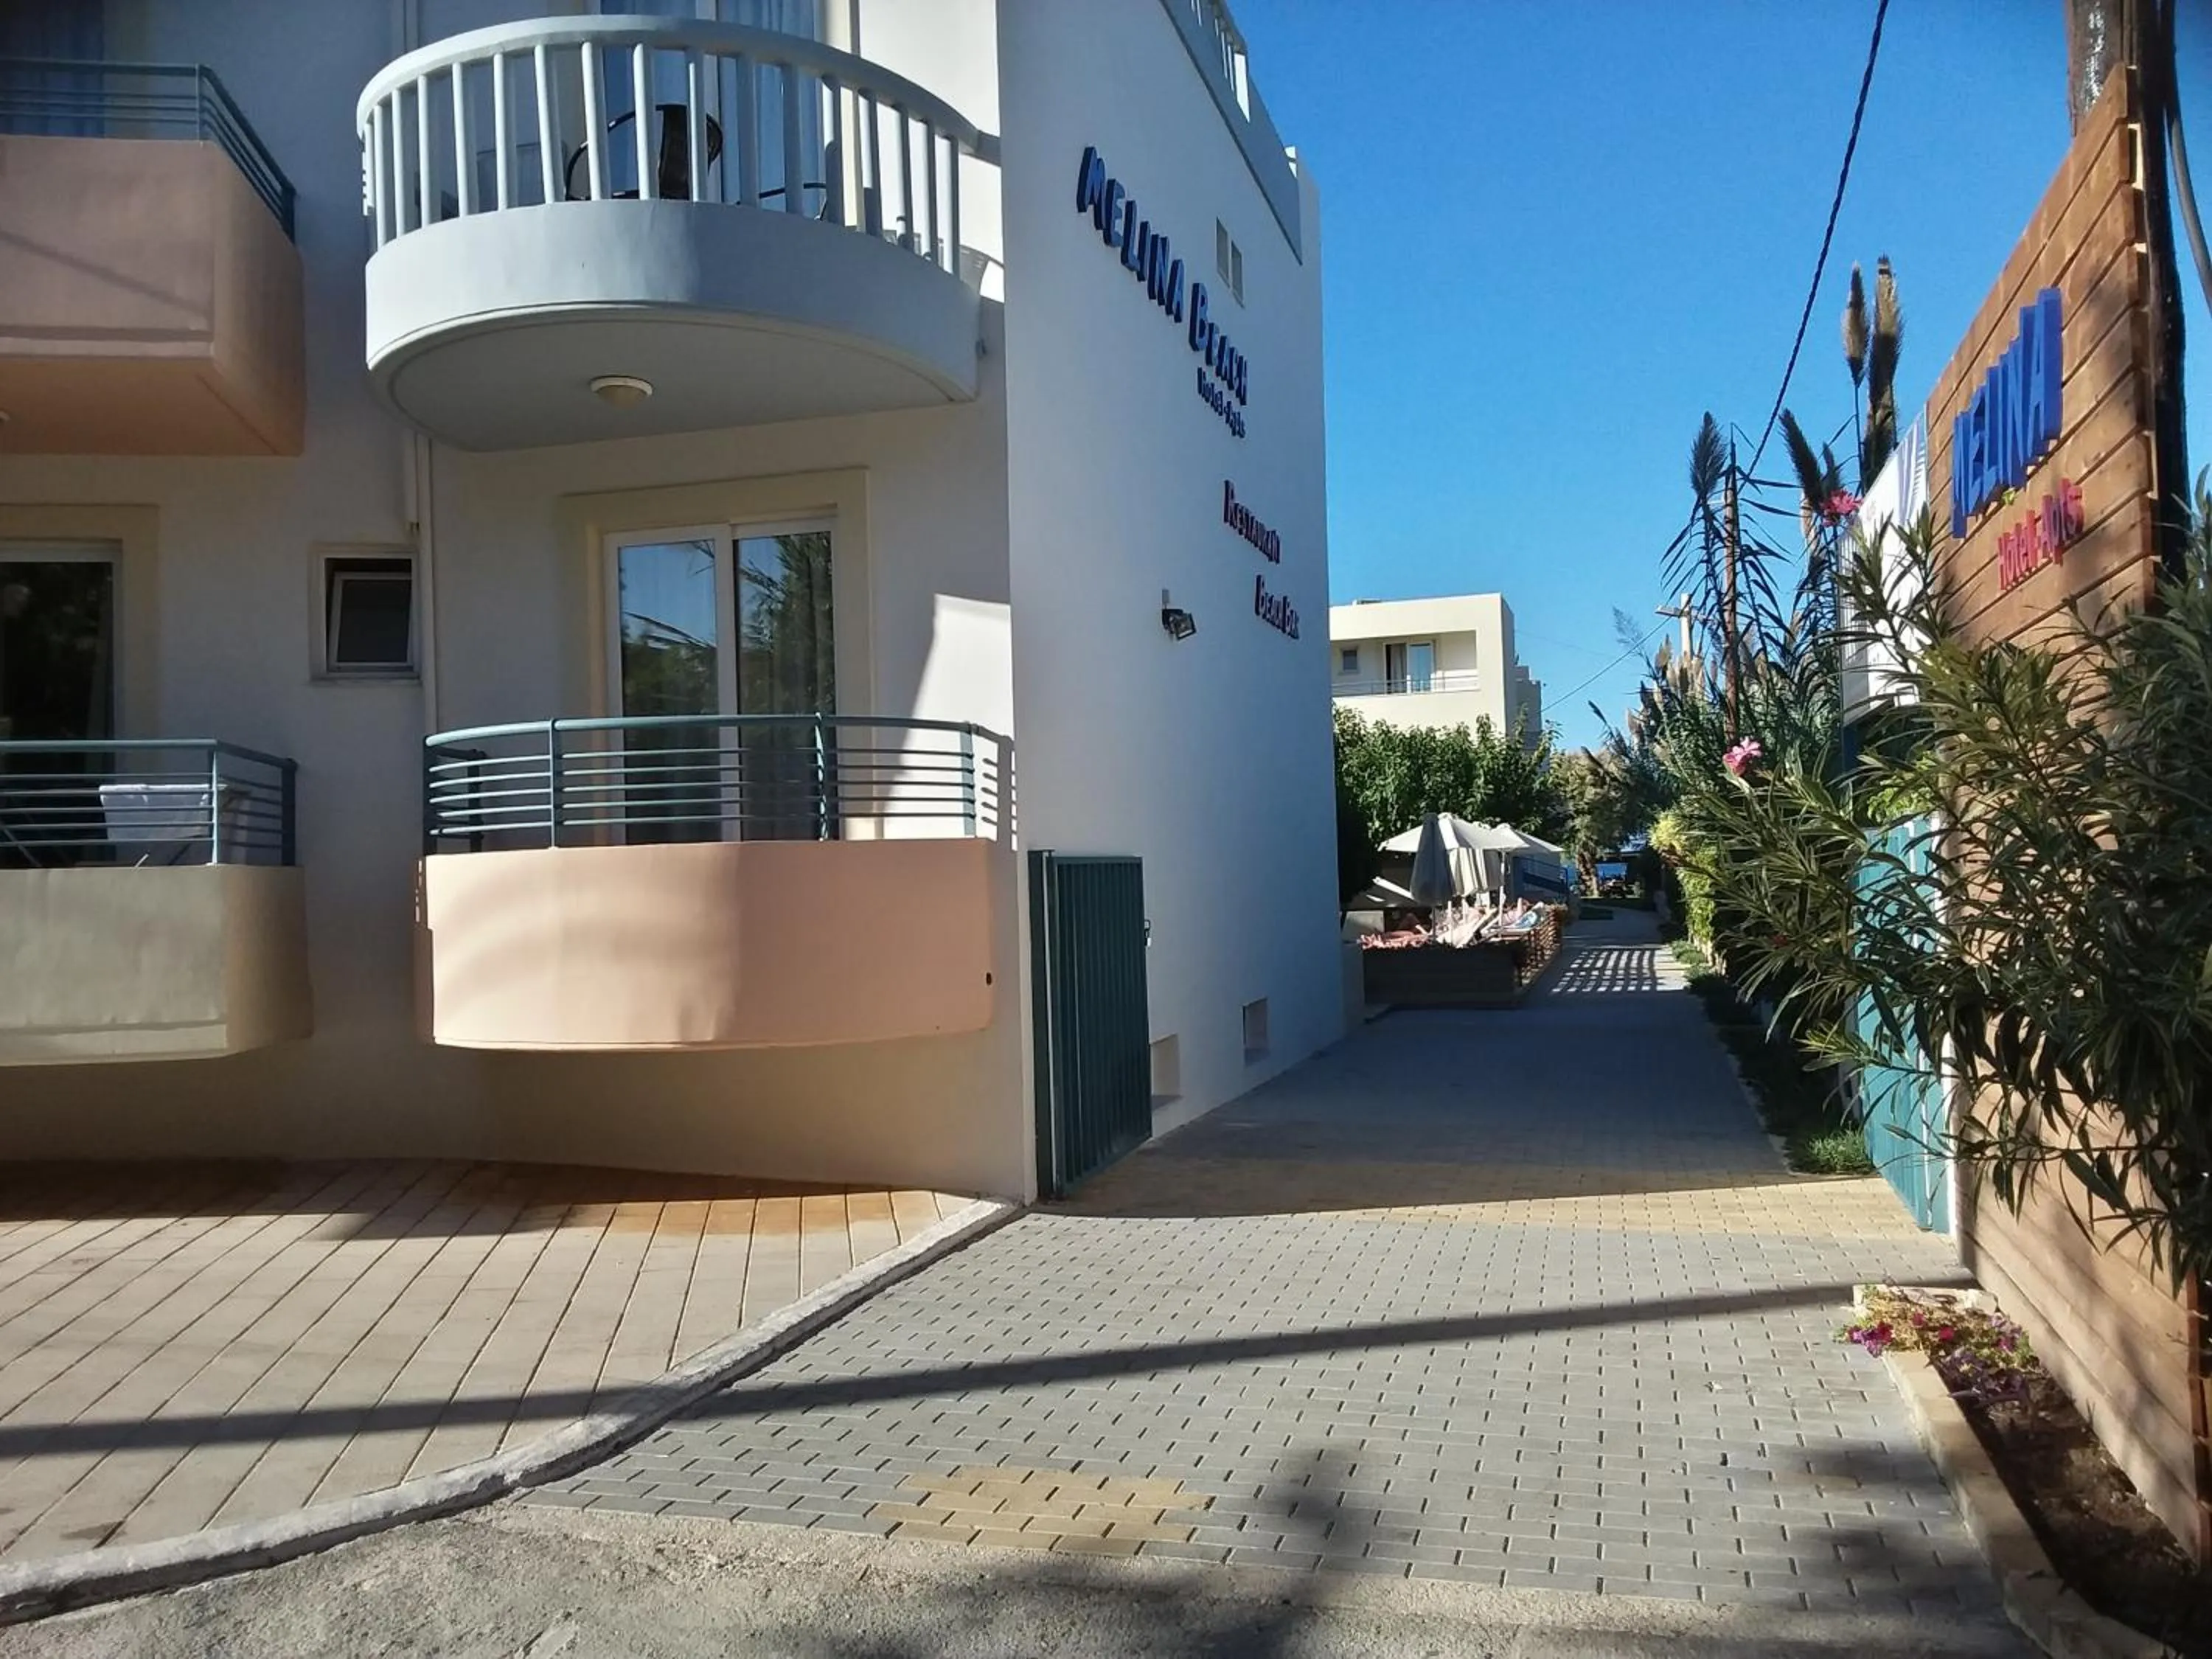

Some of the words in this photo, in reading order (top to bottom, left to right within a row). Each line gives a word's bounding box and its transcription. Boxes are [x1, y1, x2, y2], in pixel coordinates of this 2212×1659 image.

[1077, 146, 1184, 323] MELINA
[1188, 282, 1248, 406] BEACH
[1952, 287, 2062, 538] MELINA
